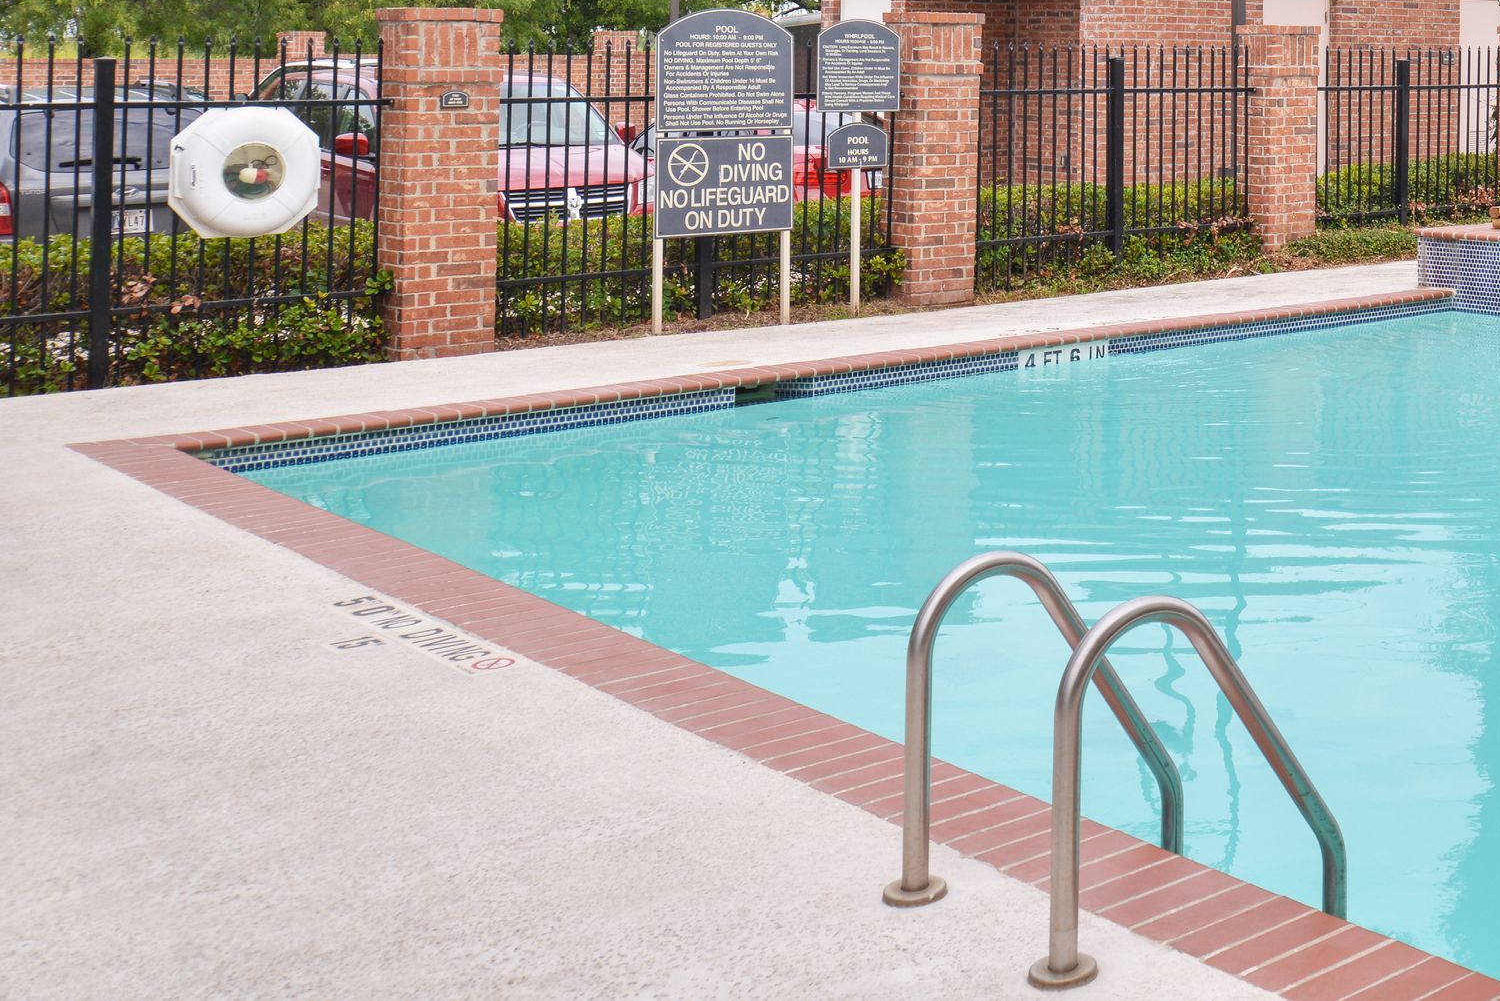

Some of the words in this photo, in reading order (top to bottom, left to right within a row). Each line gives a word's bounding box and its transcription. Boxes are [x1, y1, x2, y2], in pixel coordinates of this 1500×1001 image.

[716, 26, 738, 34] POOL
[848, 136, 870, 144] POOL
[738, 142, 766, 161] NO
[720, 162, 782, 183] DIVING
[660, 189, 688, 209] NO
[691, 185, 789, 207] LIFEGUARD
[685, 210, 712, 230] ON
[718, 207, 766, 228] DUTY
[1024, 354, 1036, 367] 4
[1044, 350, 1062, 366] FT
[1070, 348, 1080, 362] 6
[1089, 344, 1105, 360] IN
[333, 596, 376, 606] 5
[370, 614, 422, 630] NO
[400, 628, 491, 661] DIVING
